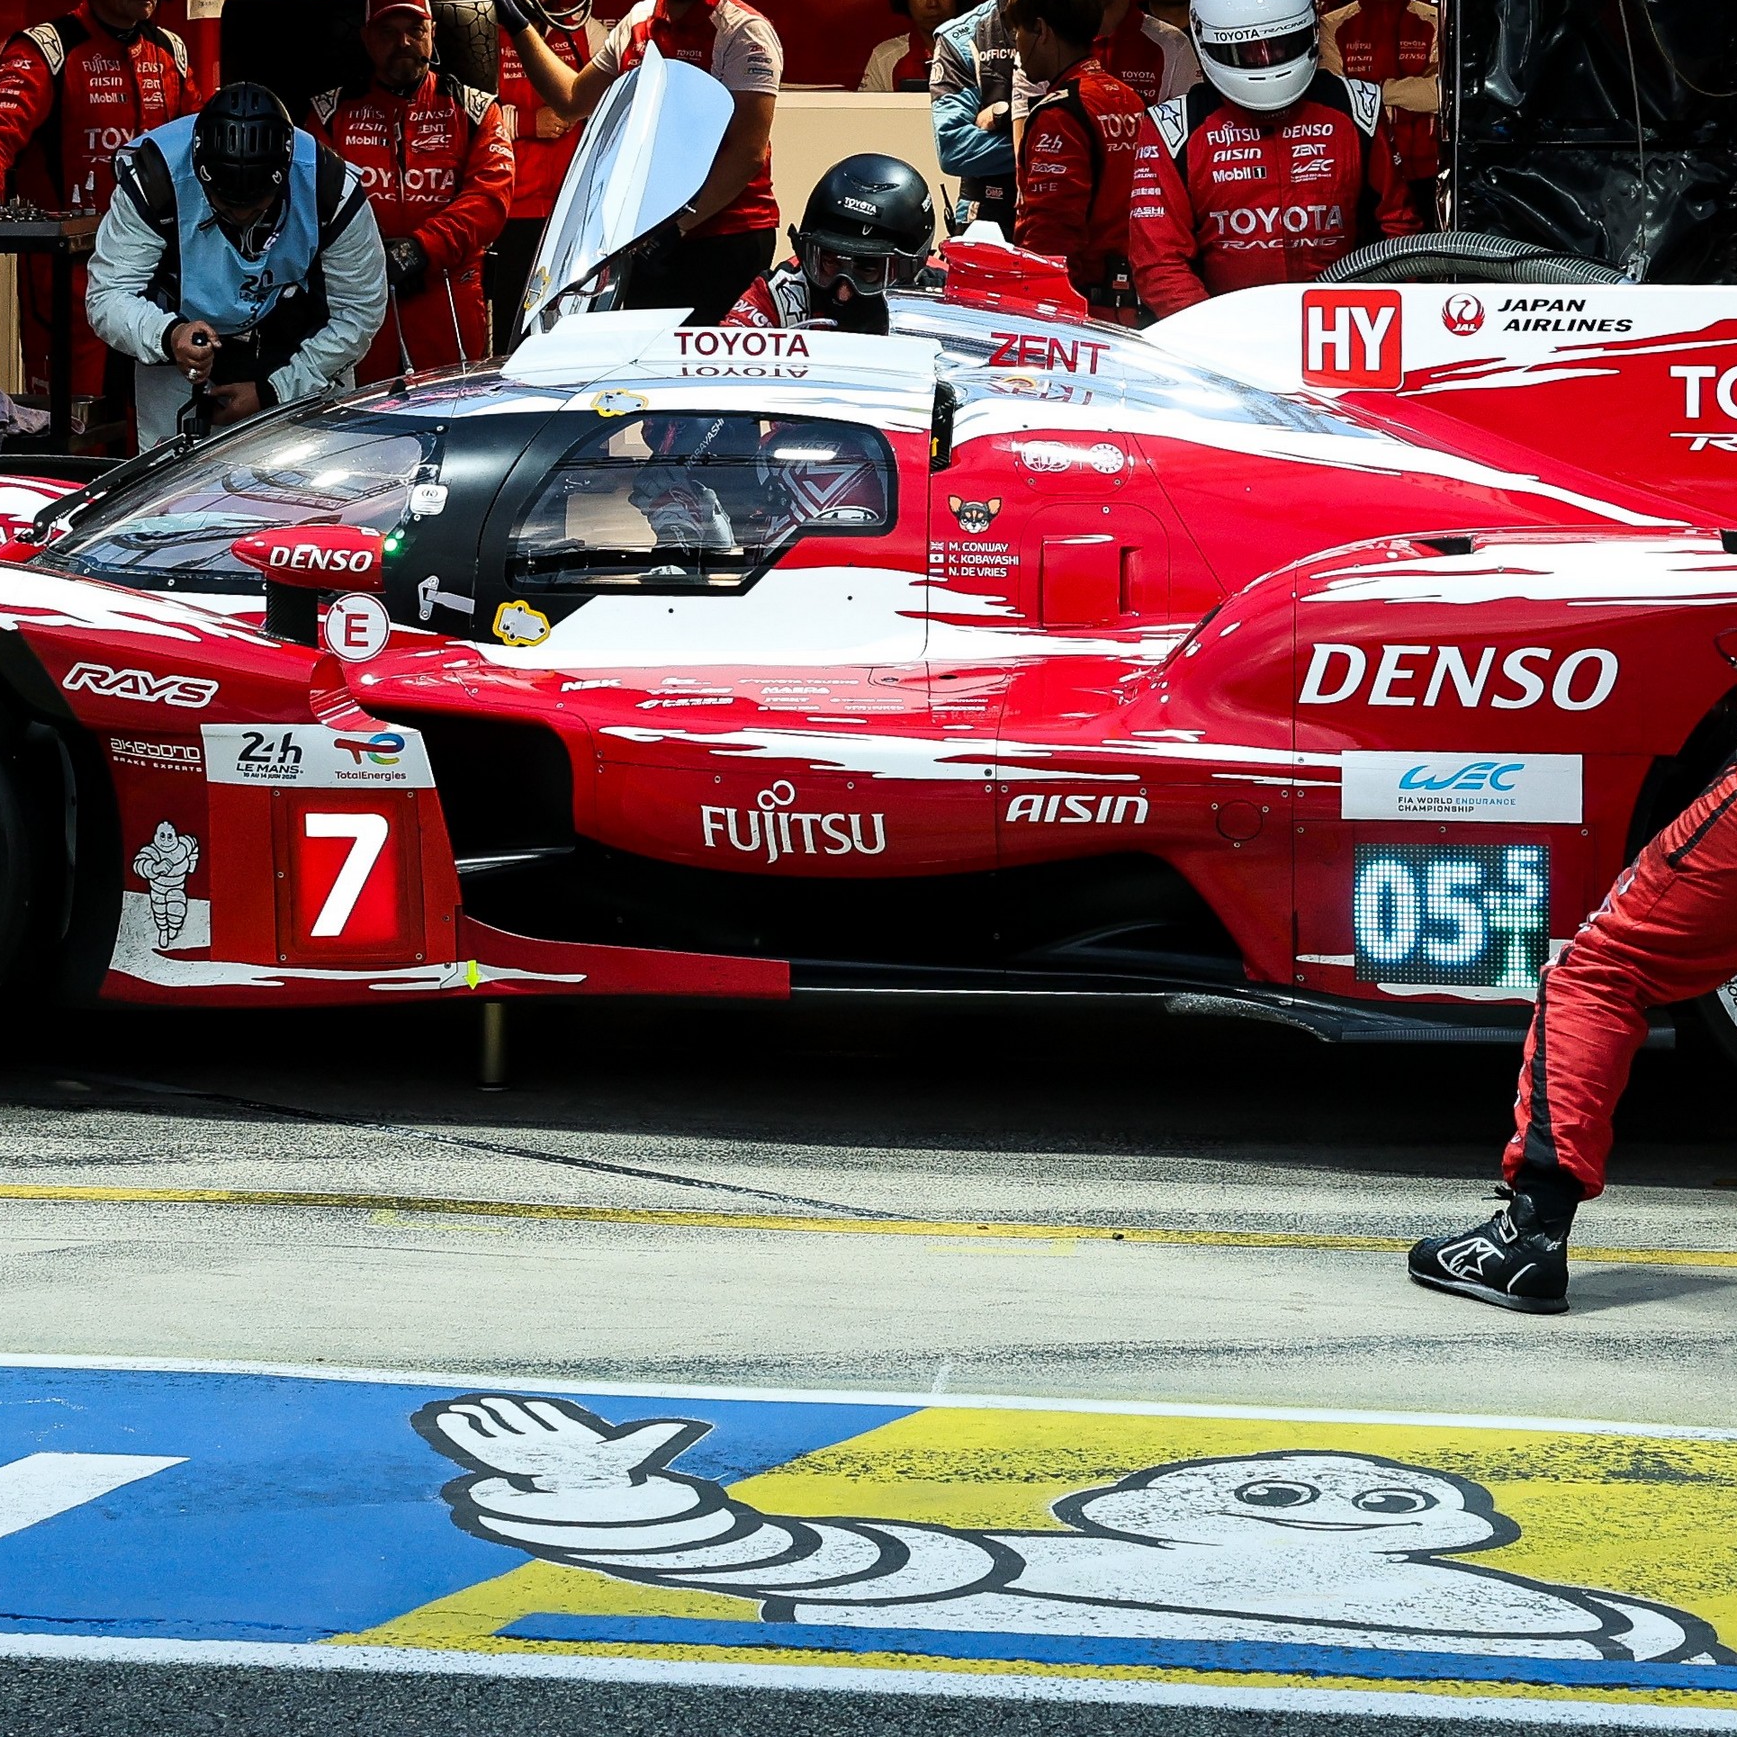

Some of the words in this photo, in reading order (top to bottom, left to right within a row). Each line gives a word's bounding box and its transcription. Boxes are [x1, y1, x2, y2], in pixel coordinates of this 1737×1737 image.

[1214, 29, 1260, 42] TOYOTA
[1206, 122, 1261, 147] FUJITSU
[1282, 123, 1334, 139] DENSO
[1213, 148, 1262, 162] AISIN
[1209, 205, 1345, 236] TOYOTA
[1498, 298, 1587, 313] JAPAN
[1503, 317, 1633, 333] AIRLINES
[674, 332, 810, 357] TOYOTA
[1307, 305, 1396, 372] HY
[988, 332, 1111, 375] ZENT
[270, 545, 374, 573] DENSO
[949, 543, 961, 551] M.
[964, 543, 1008, 552] CONWAY
[949, 555, 959, 563] K.
[961, 555, 1019, 565] KOBAYASHI
[949, 567, 960, 576] N.
[961, 567, 974, 576] DE
[975, 567, 1007, 577] VRIES
[344, 613, 369, 648] E
[63, 662, 219, 708] RAYS
[1298, 643, 1619, 711] DENSO
[238, 732, 303, 764] 24h
[113, 756, 146, 766] BRAKE
[153, 763, 202, 772] EXPERTS
[236, 763, 256, 772] LE
[258, 764, 300, 774] MANS
[335, 770, 406, 781] TotalEnergies
[1398, 761, 1526, 790] WEC
[1005, 794, 1149, 824] AISIN
[1398, 797, 1415, 805] FIA
[1417, 797, 1453, 806] WORLD
[1455, 797, 1516, 806] ENDURANCE
[1398, 804, 1475, 813] CHAMPIONSHIP
[700, 780, 886, 864] FUJITSU
[305, 813, 389, 937] 7
